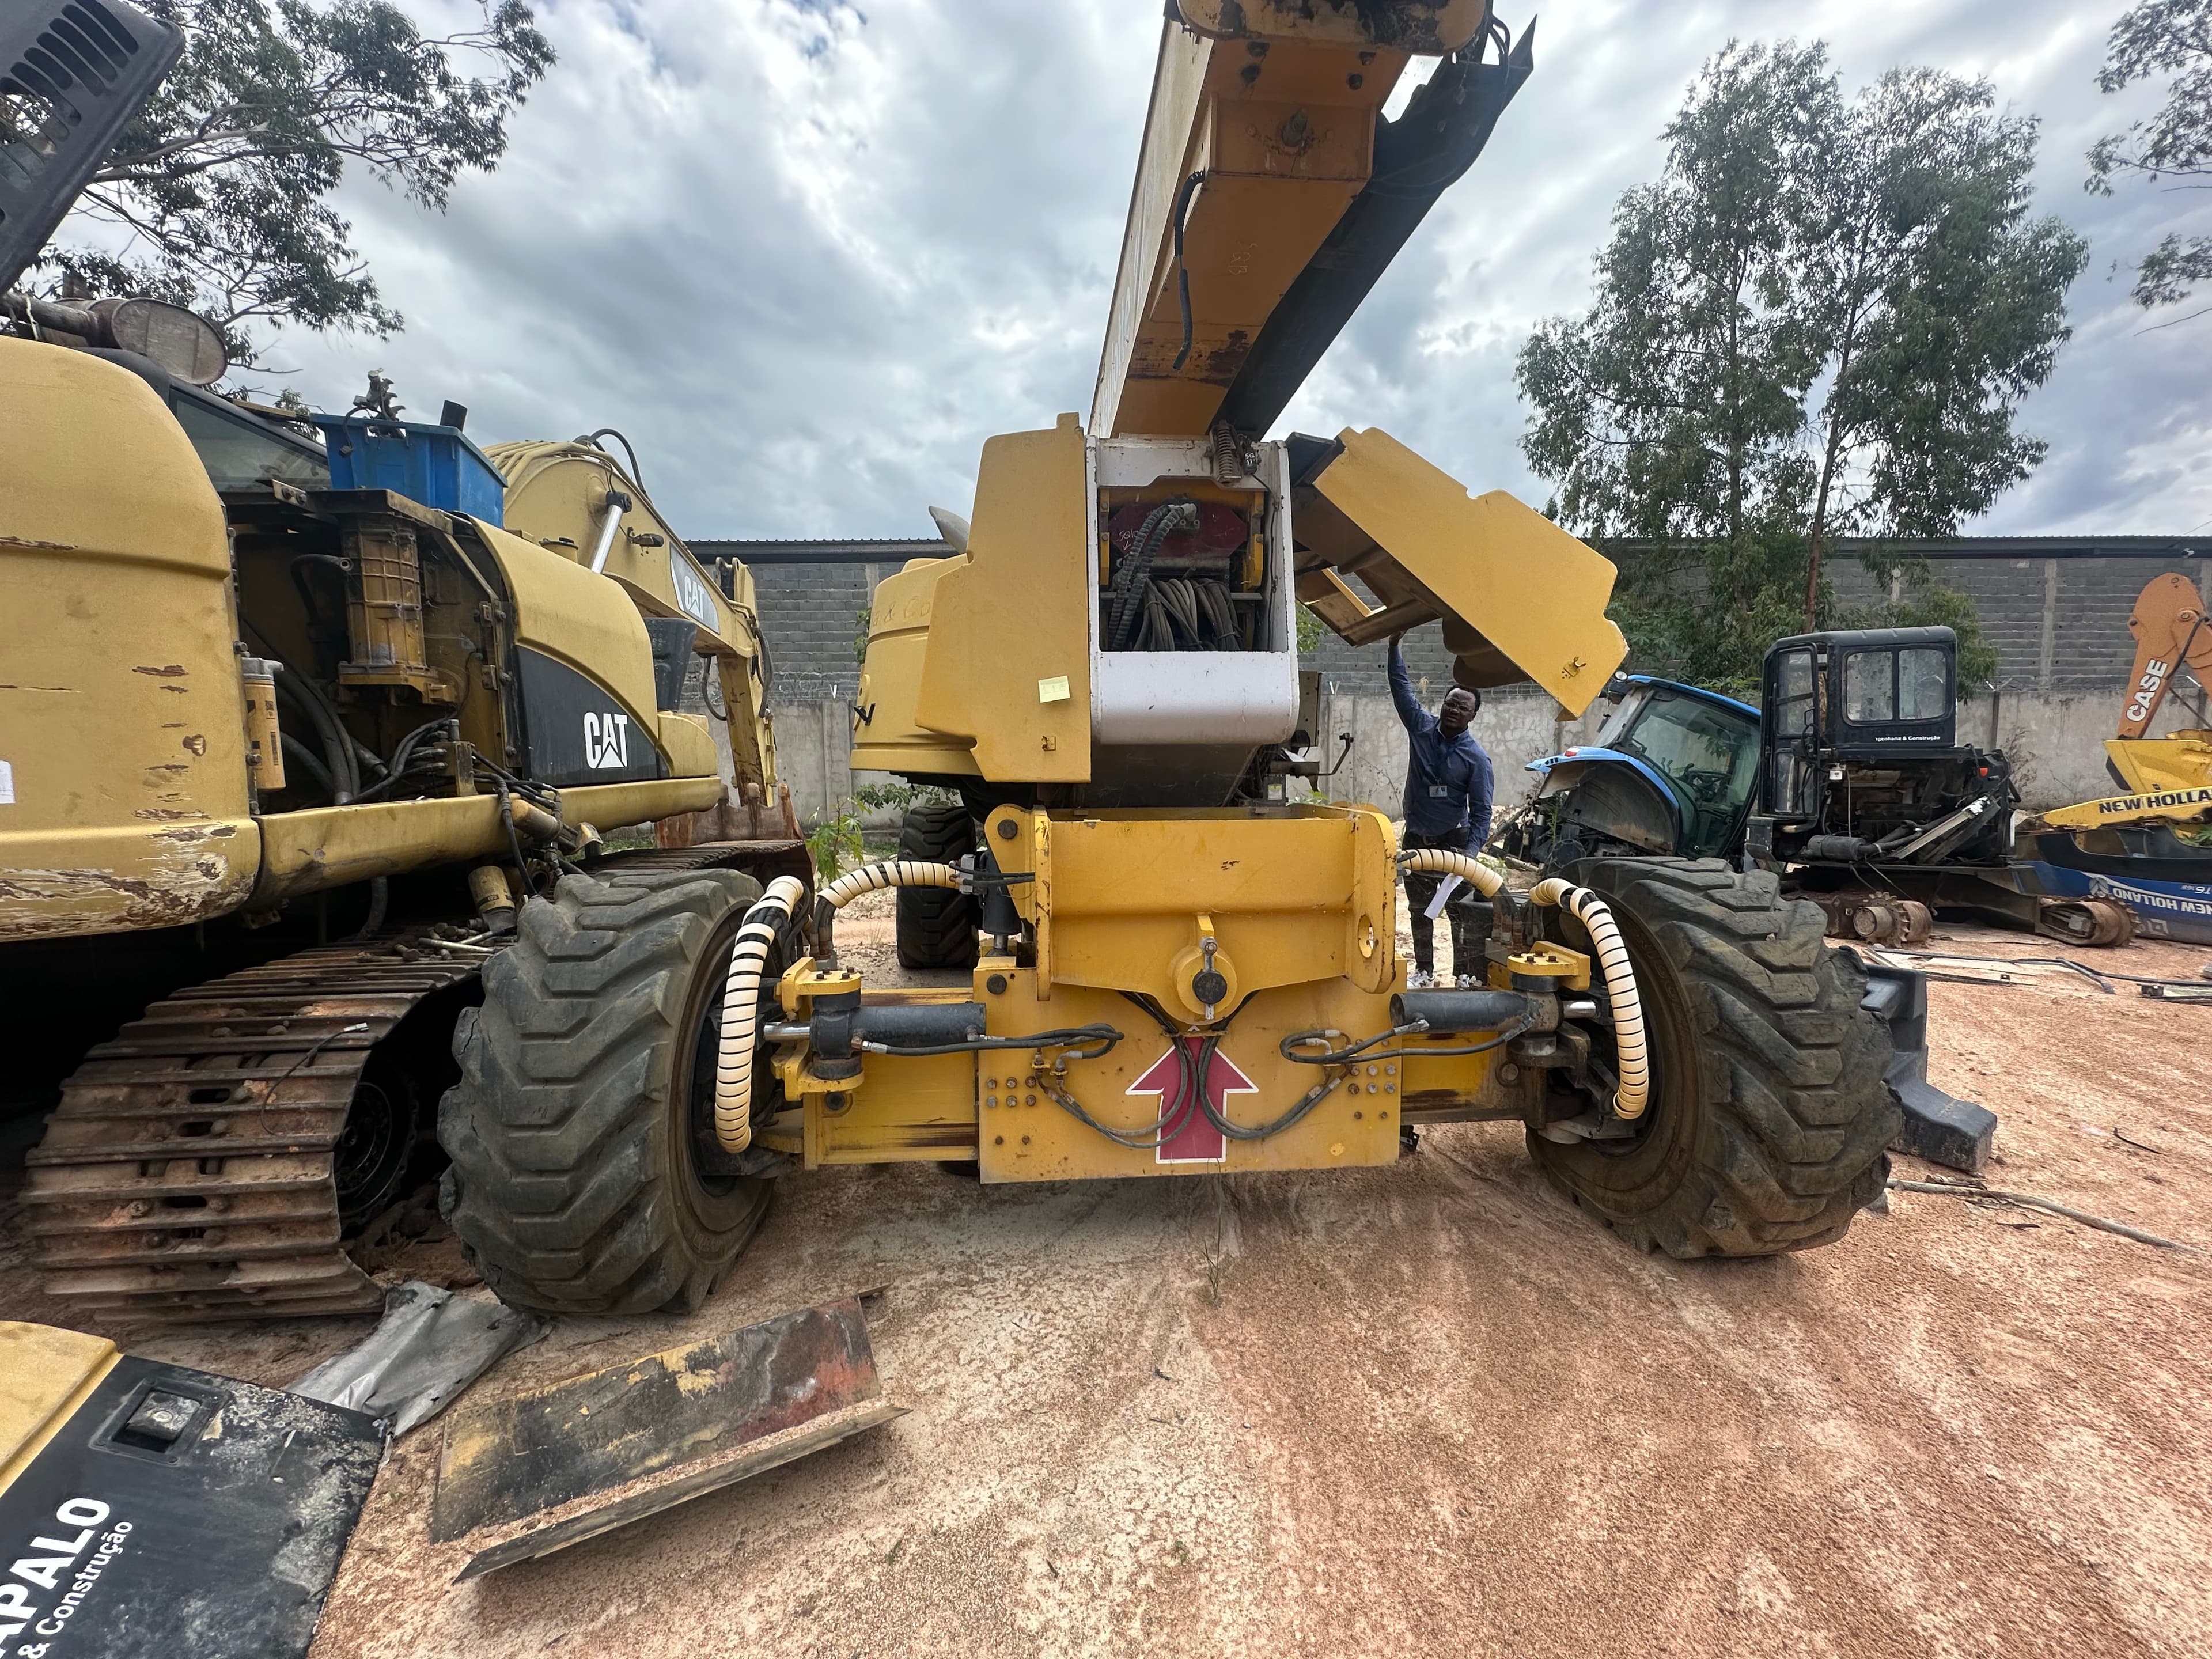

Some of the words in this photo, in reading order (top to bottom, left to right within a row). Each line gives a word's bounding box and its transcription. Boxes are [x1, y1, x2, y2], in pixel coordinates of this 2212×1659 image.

[684, 576, 704, 620] CAT
[2127, 658, 2168, 722] CASE
[584, 711, 628, 769] CAT
[2099, 798, 2141, 813] NEW
[2112, 888, 2178, 910] HOLLAND
[17, 1642, 50, 1659] &
[35, 1521, 134, 1635] Construção
